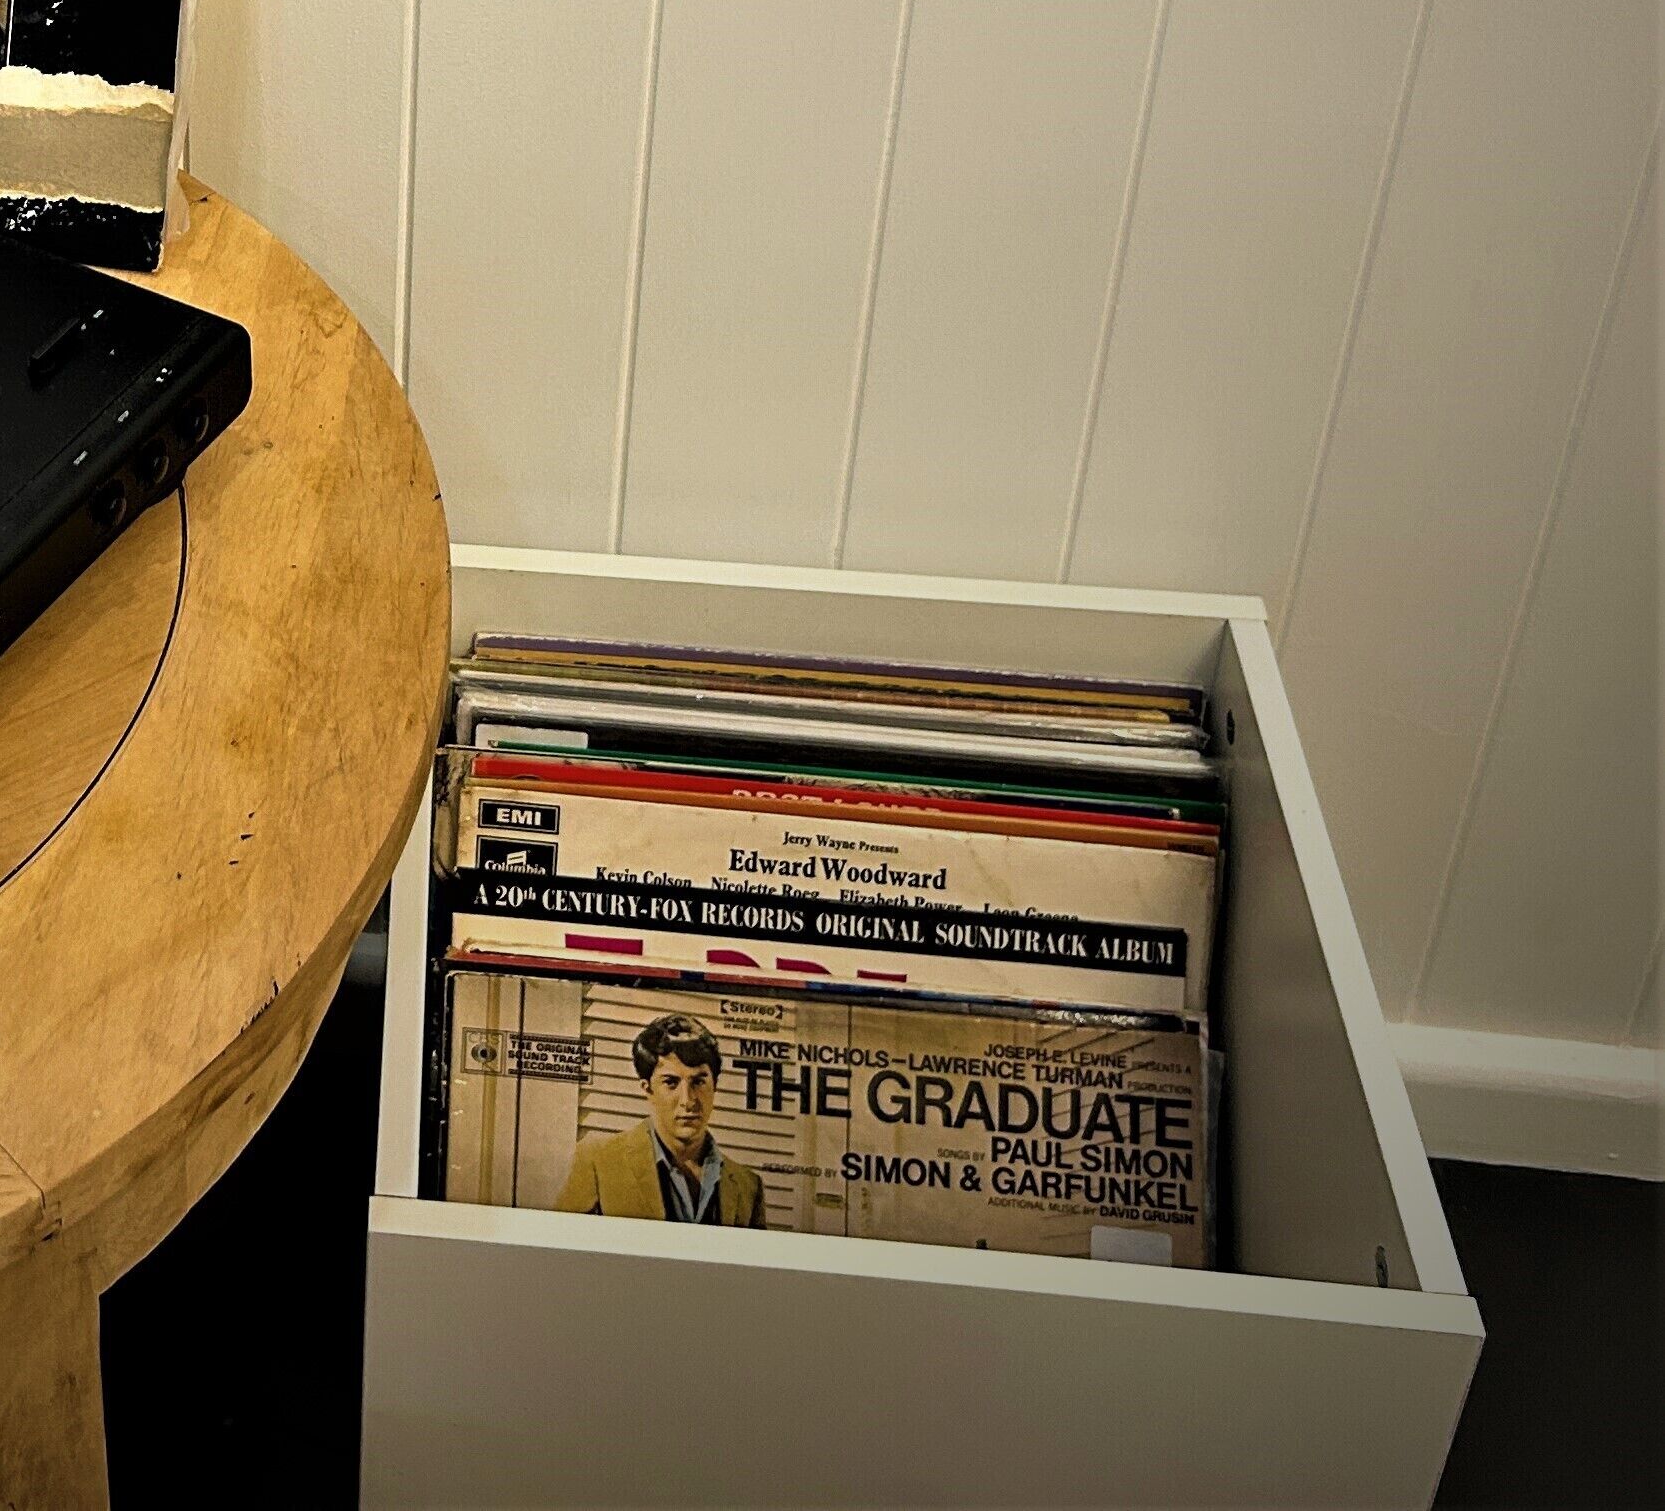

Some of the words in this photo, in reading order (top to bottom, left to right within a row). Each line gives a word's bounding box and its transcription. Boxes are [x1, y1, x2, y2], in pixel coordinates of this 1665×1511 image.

[496, 807, 542, 826] EMI
[783, 831, 812, 848] Jerry
[816, 834, 856, 852] Wayne
[858, 841, 899, 854] Presents
[596, 866, 638, 885] Kevin
[643, 870, 692, 888] Colson
[711, 876, 777, 895] Nicolette
[728, 848, 816, 879] Edward
[820, 857, 947, 890] Woodward
[474, 883, 489, 906] A
[495, 884, 536, 908] 20th
[542, 890, 693, 924] CENTURY-FOX
[701, 901, 805, 933] RECORDS
[816, 912, 925, 944] ORIGINAL
[935, 923, 1088, 958] SOUNDTRACK
[1095, 937, 1174, 966] ALBUM
[730, 1000, 776, 1017] Stereo
[508, 1050, 549, 1062] SOUND
[552, 1053, 590, 1065] TRACK
[511, 1040, 532, 1051] THE
[536, 1042, 590, 1056] ORIGINAL
[985, 1043, 1047, 1061] JOSEPH
[1070, 1051, 1126, 1069] LEVINE
[516, 1060, 582, 1074] RECORDING
[740, 1039, 790, 1060] MIKE
[1032, 1064, 1123, 1089] TURMAN
[732, 1059, 852, 1118] THE
[867, 1070, 1193, 1149] GRADUATE
[991, 1136, 1073, 1169] PAUL
[1080, 1144, 1193, 1180] SIMON
[841, 1152, 951, 1189] SIMON
[959, 1164, 982, 1192] &
[991, 1166, 1199, 1212] GARFUNKEL
[1099, 1205, 1139, 1221] DAVID
[1142, 1208, 1195, 1225] GRUSIN
